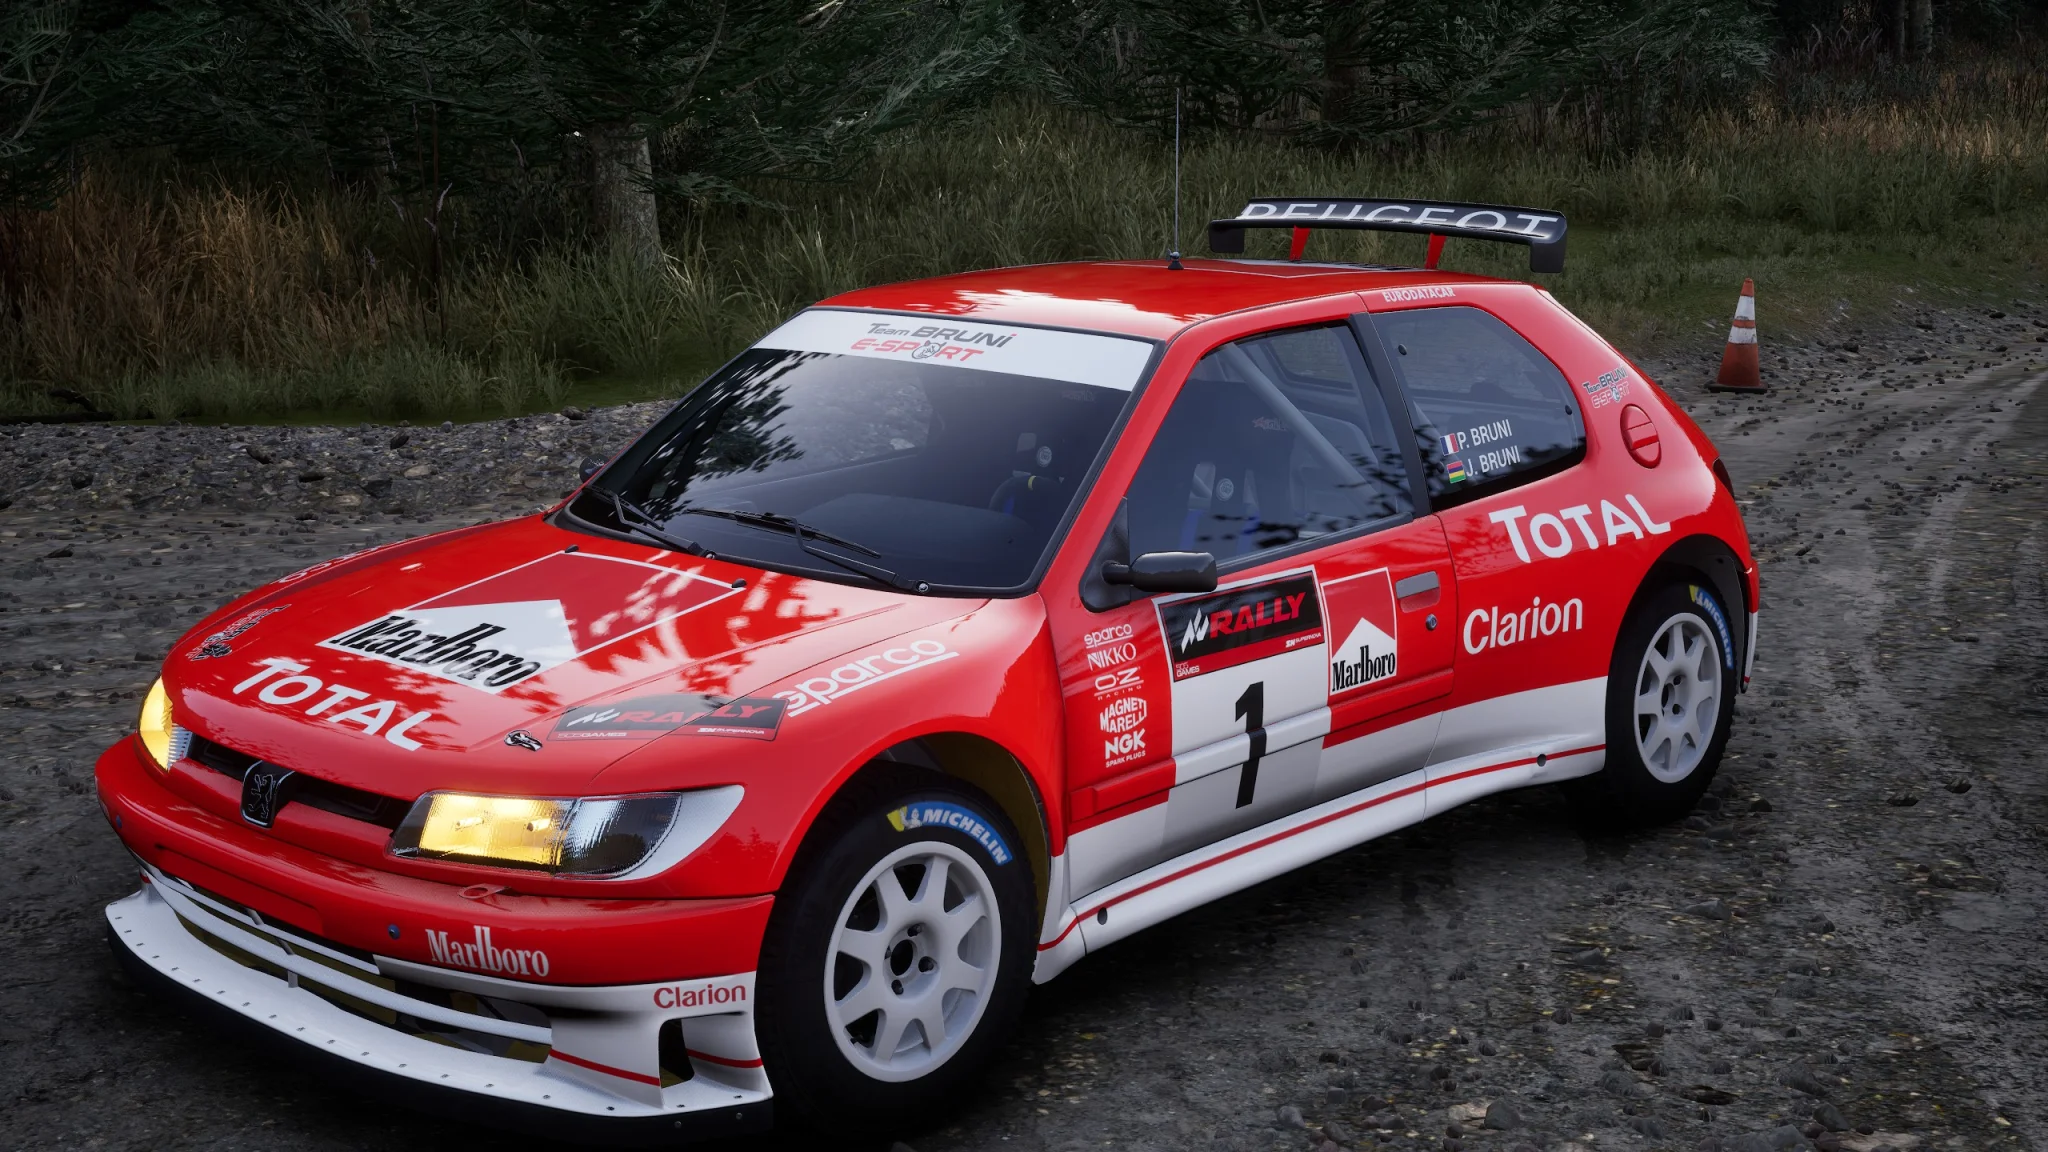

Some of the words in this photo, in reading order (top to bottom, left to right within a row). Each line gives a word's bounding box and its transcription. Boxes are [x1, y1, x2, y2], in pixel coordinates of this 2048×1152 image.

[1382, 286, 1456, 302] EURODATACAR
[867, 322, 909, 336] Team
[1457, 431, 1470, 450] P.
[1470, 419, 1513, 446] BRUNI
[1466, 458, 1478, 477] J.
[1479, 445, 1521, 473] BRUNI
[1488, 493, 1672, 564] TOTAL
[1209, 592, 1306, 639] RALLY
[1463, 596, 1583, 655] Clarion
[1703, 597, 1732, 668] MICHELIN
[329, 615, 541, 688] Marlboro
[1084, 624, 1133, 648] sparco
[772, 639, 948, 711] sparco
[1087, 642, 1137, 671] NIKKO
[1176, 665, 1200, 678] GAMES
[1332, 645, 1396, 692] Marlboro
[232, 657, 432, 752] TOTAL
[1097, 684, 1142, 701] RACING
[1105, 728, 1146, 760] NGK
[1105, 757, 1125, 768] SPARK
[1126, 750, 1146, 761] PLUGS
[1235, 681, 1267, 810] 1
[923, 808, 1008, 864] MICHELIN
[425, 925, 550, 977] Marlboro
[653, 983, 747, 1010] Clarion
